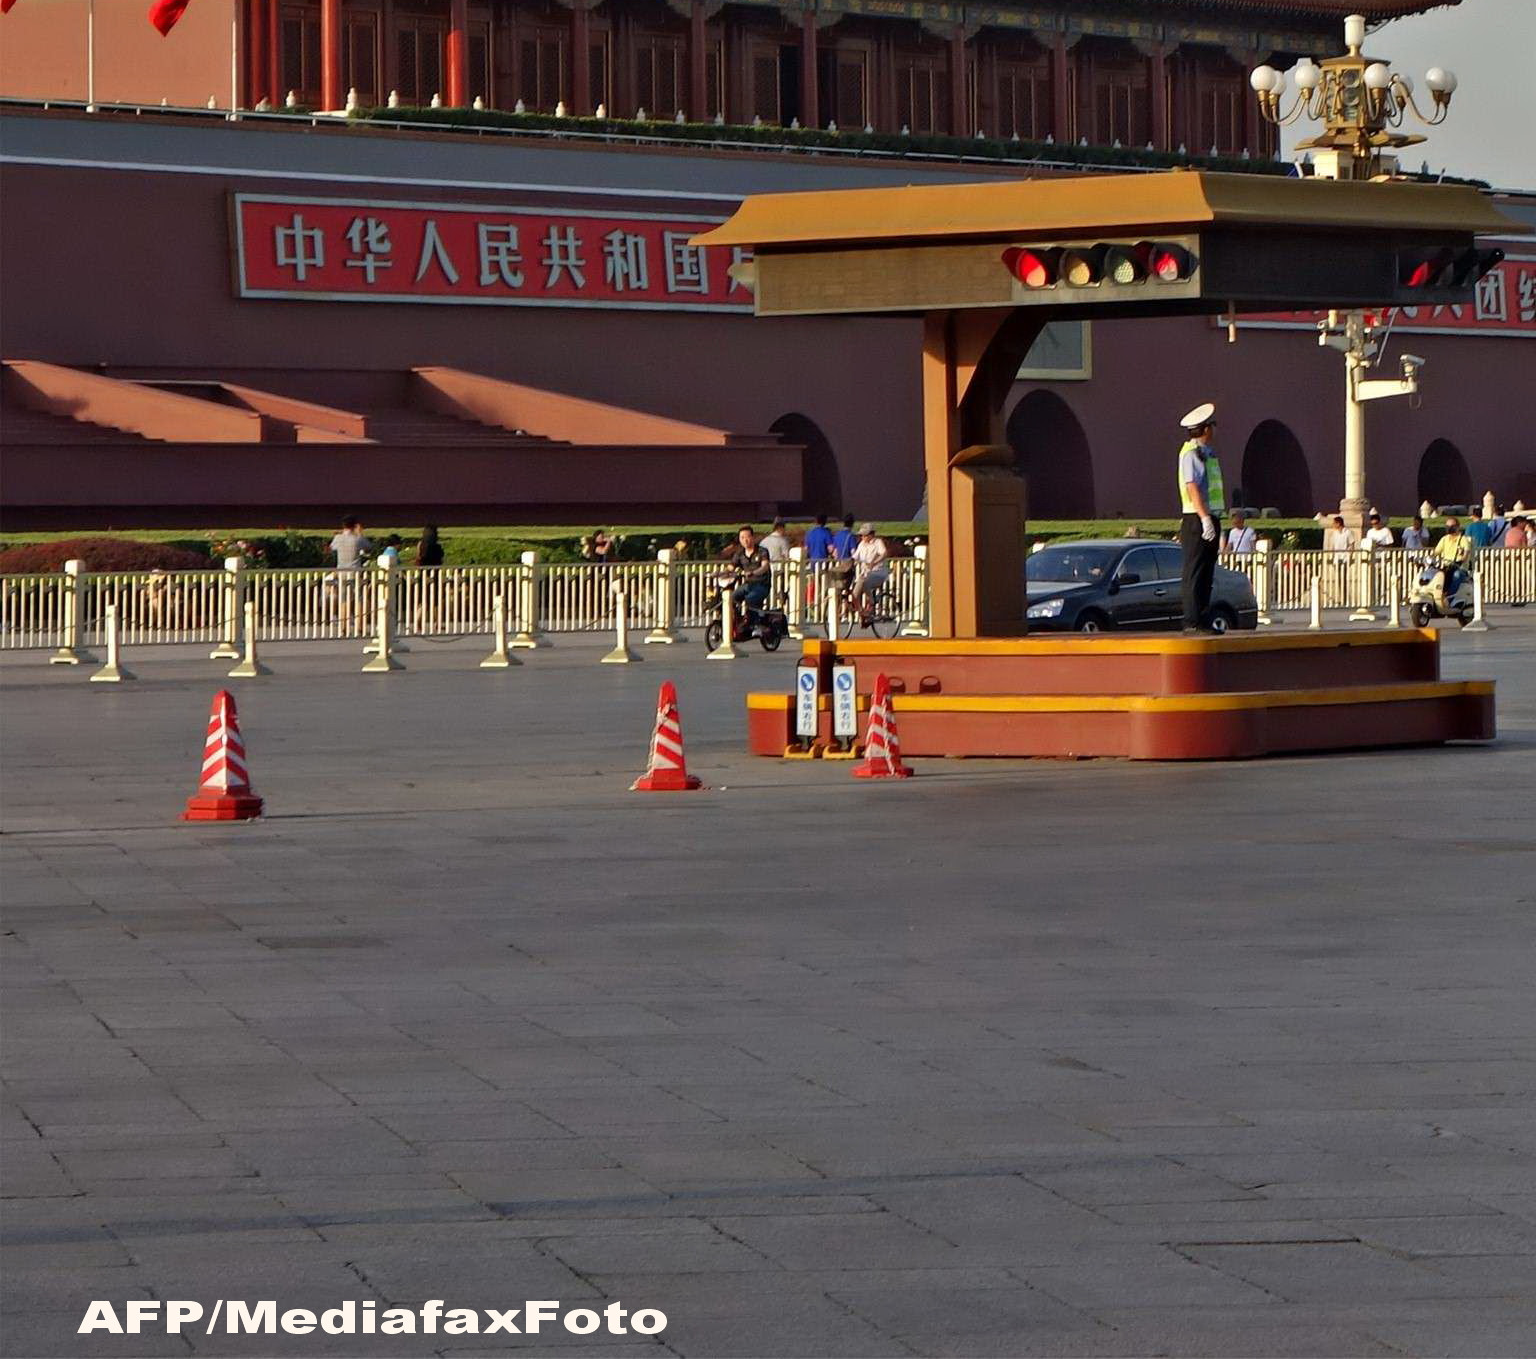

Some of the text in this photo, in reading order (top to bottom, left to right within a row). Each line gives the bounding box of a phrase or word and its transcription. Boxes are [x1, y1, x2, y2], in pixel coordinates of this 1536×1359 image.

[274, 213, 754, 295] 中华人民共和国
